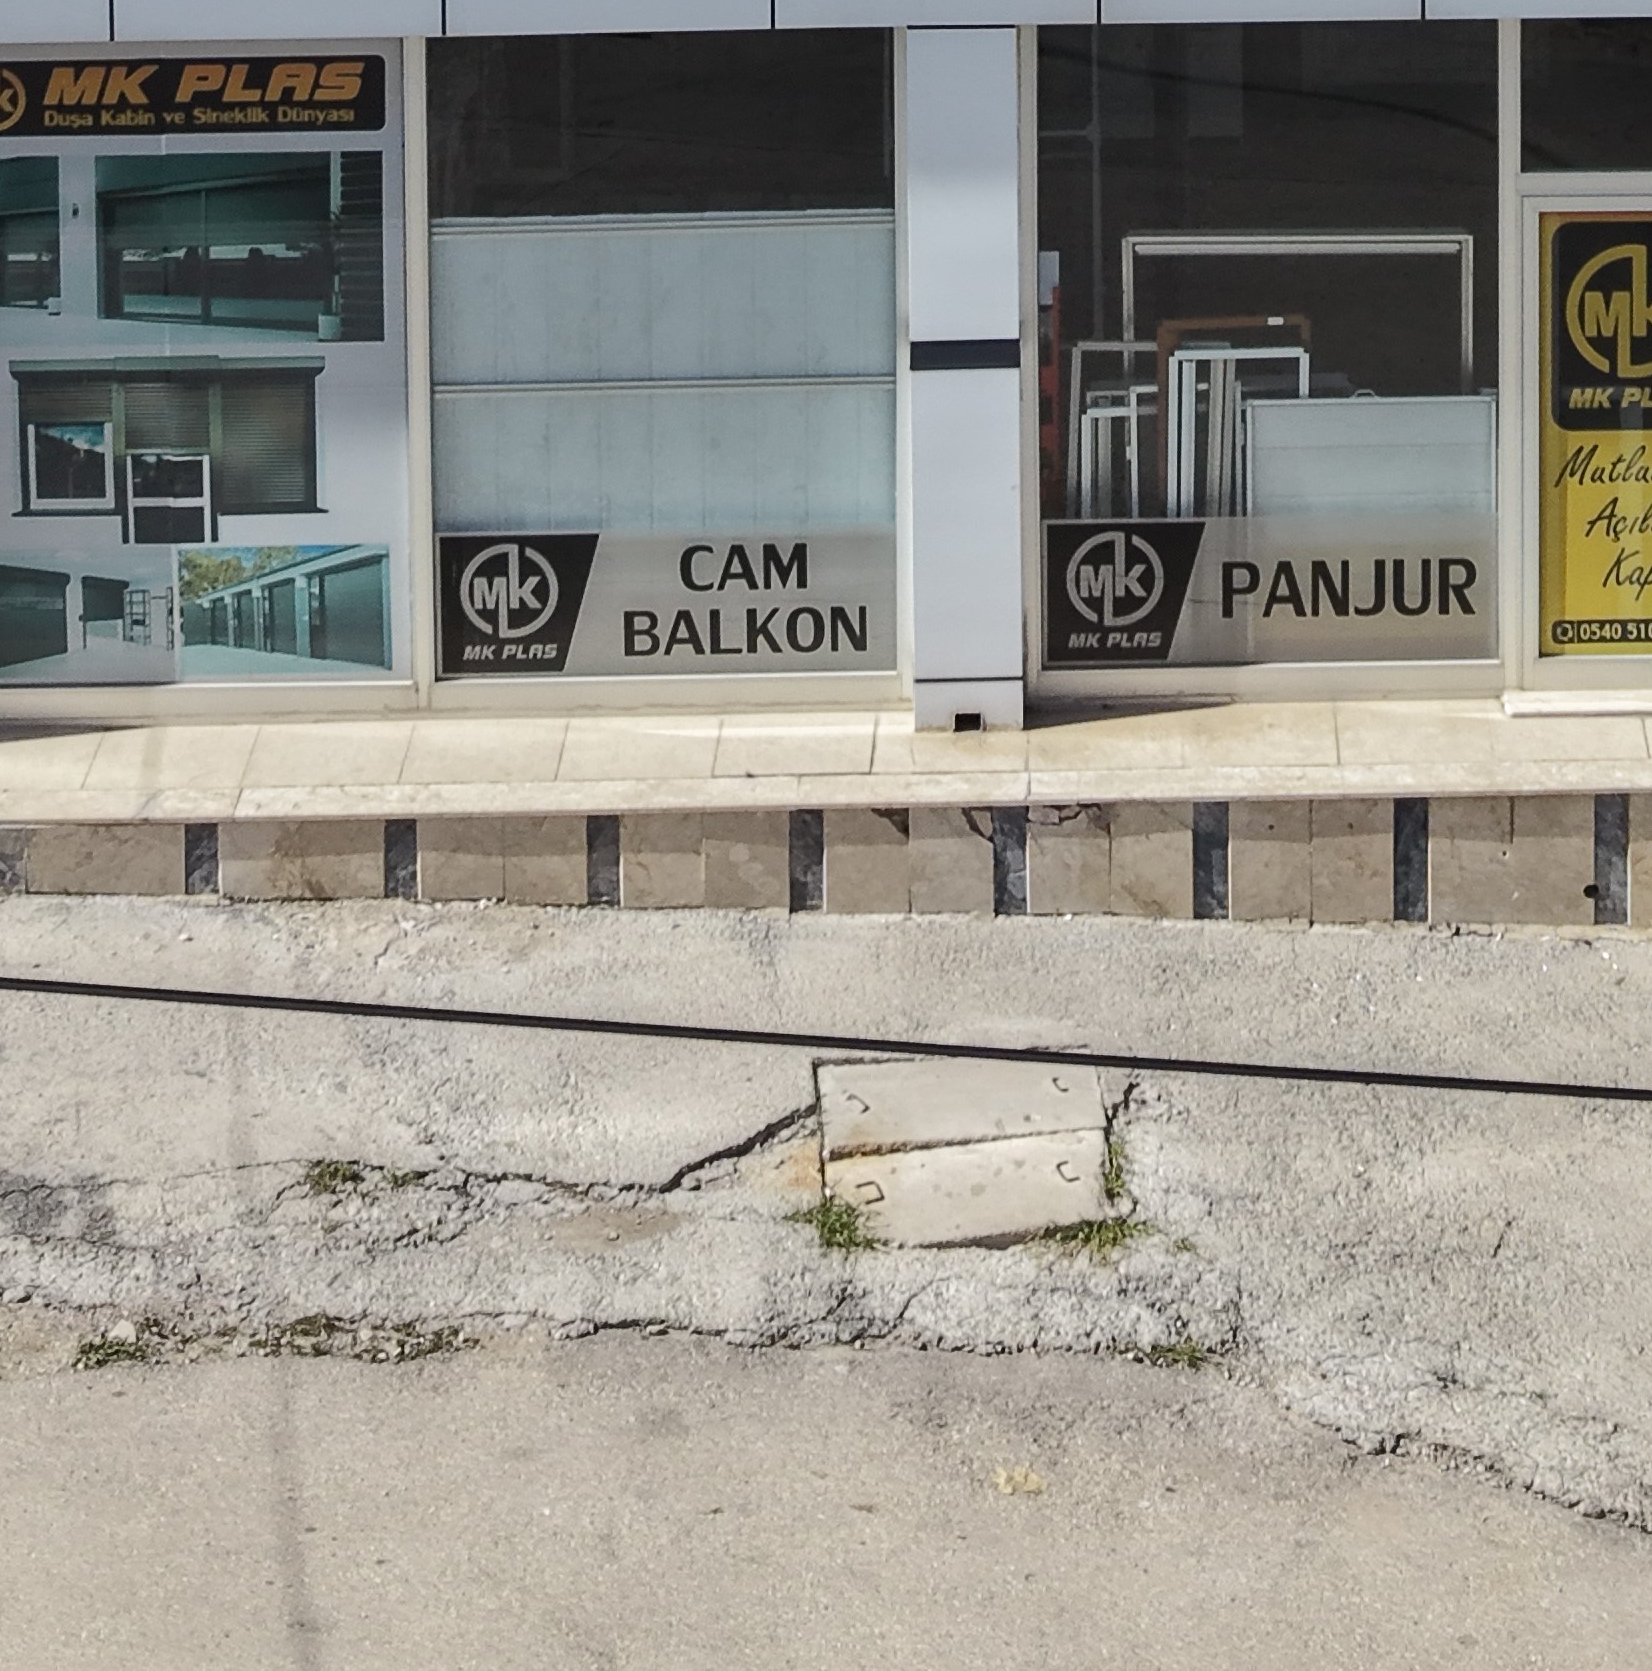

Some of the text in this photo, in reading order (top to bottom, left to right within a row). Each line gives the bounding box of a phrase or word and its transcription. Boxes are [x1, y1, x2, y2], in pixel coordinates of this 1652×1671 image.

[42, 62, 366, 105] MK PLAS
[100, 108, 156, 127] Kabin
[162, 111, 186, 124] ve
[193, 106, 270, 125] Sineklik
[1568, 387, 1614, 409] MK
[679, 541, 809, 593] CAM
[1220, 557, 1478, 620] PANJUR
[622, 604, 868, 658] BALKON
[1067, 631, 1163, 649] MK PLAS
[1579, 621, 1623, 640] 0540
[463, 642, 558, 662] MK PLAS
